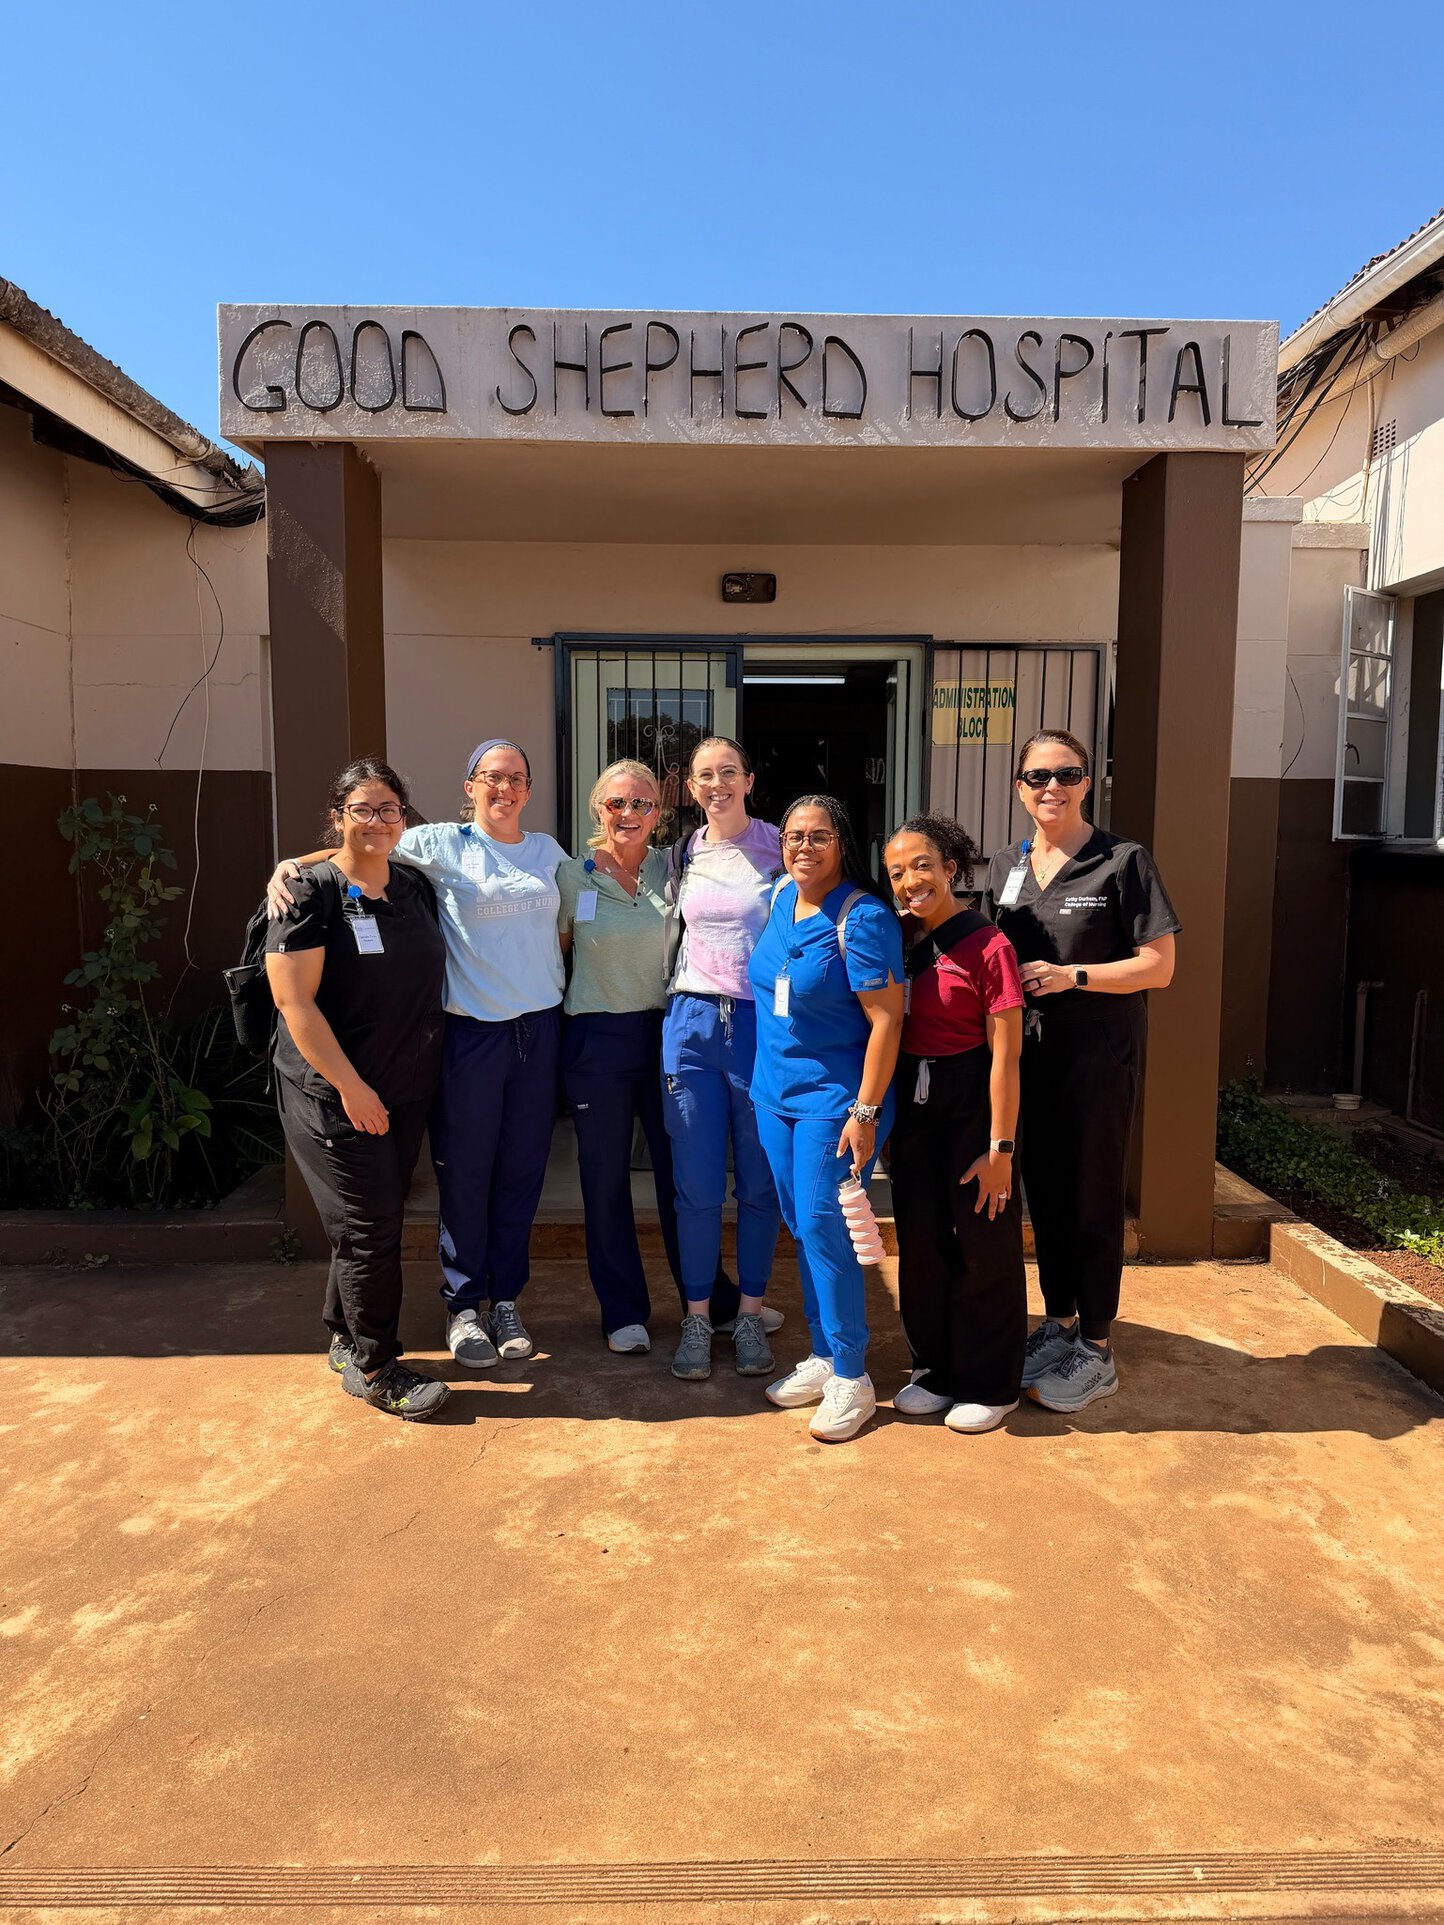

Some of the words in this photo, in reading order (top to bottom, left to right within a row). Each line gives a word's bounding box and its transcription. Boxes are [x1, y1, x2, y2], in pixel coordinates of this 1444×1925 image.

[233, 319, 448, 413] GOOD
[496, 320, 867, 420] SHEPHERD
[906, 325, 1264, 428] HOSPITAL
[477, 904, 520, 916] COLLEGE
[521, 900, 533, 911] OF
